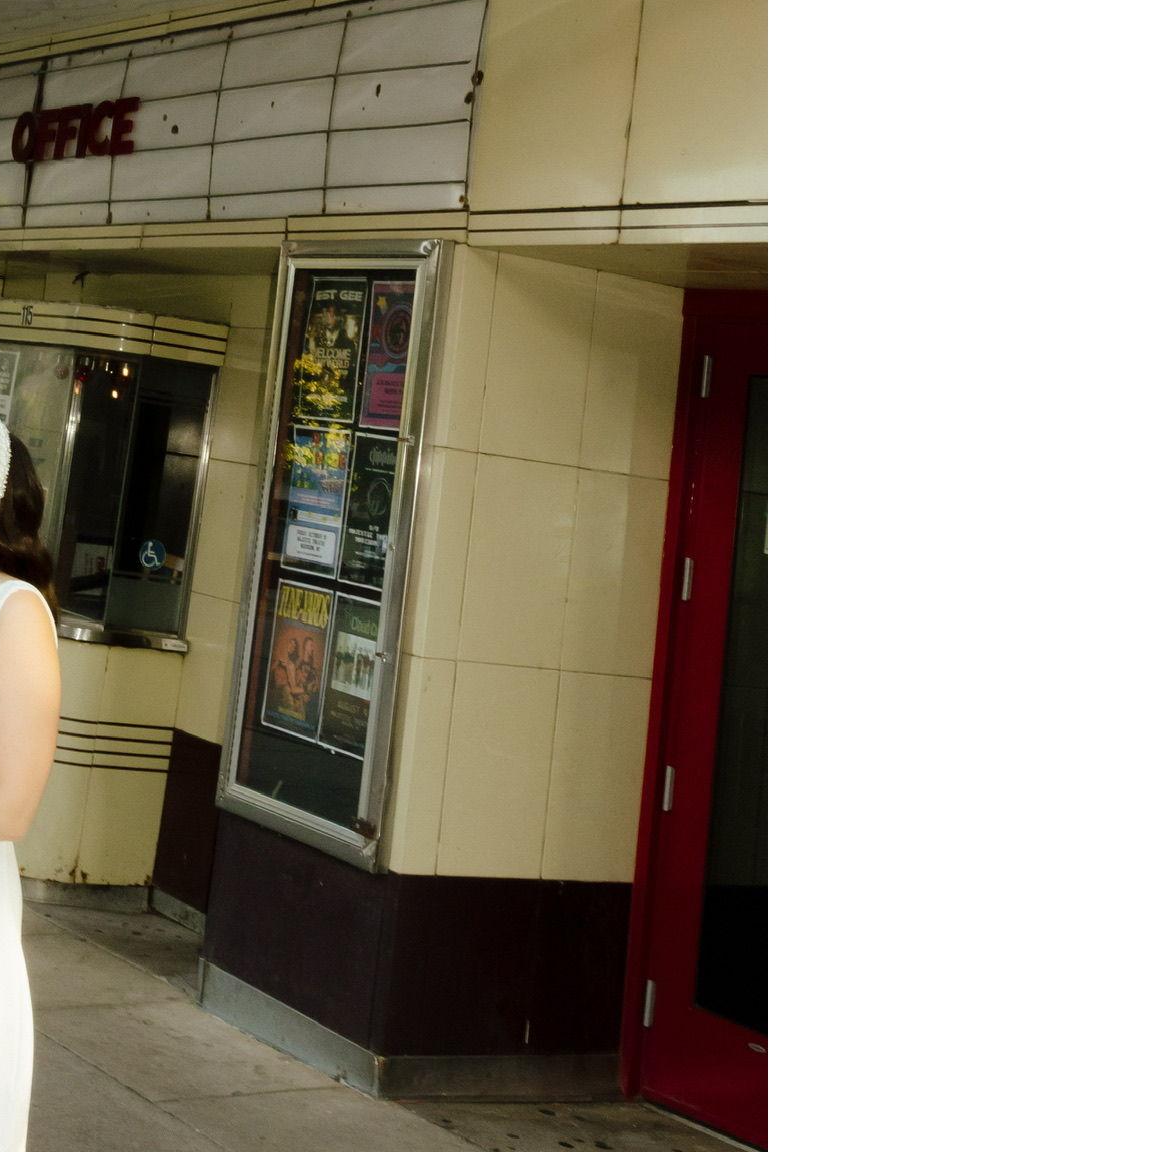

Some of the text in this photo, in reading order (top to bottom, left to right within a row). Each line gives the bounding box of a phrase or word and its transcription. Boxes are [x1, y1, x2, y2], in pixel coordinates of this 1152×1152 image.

[11, 96, 141, 164] OFFICE
[315, 290, 364, 302] EST GEE
[21, 304, 33, 326] 115
